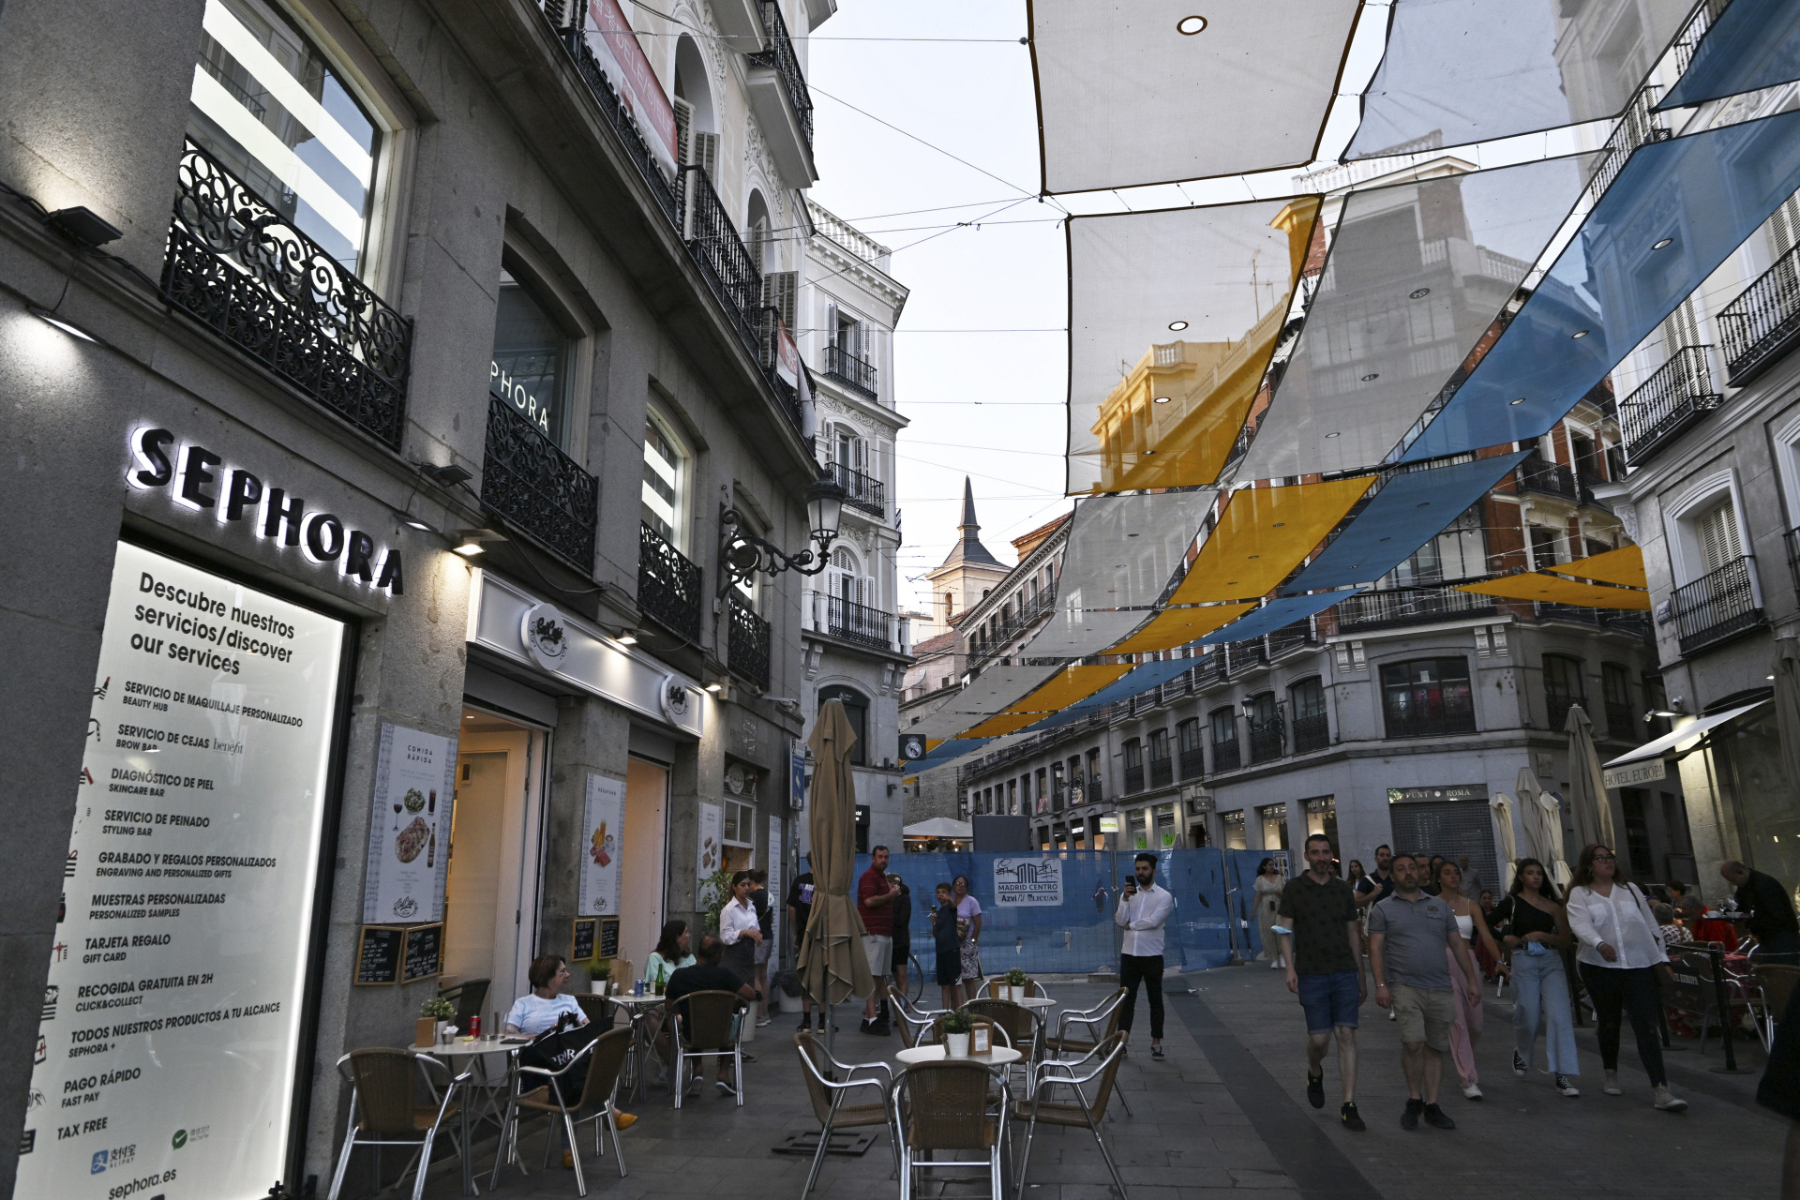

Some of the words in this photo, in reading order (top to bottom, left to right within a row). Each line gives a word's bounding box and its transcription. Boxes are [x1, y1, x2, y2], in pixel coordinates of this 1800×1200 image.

[127, 427, 403, 597] SEPHORA
[139, 572, 226, 617] Descubre
[230, 606, 295, 639] nuestros
[134, 604, 293, 663] servicios/discover
[130, 633, 163, 655] our
[168, 643, 240, 675] services
[122, 696, 152, 710] BEAUTY
[152, 701, 168, 712] HUB
[124, 681, 171, 700] SERVICIO
[173, 691, 185, 704] DE
[187, 693, 240, 715] MAQUILLAJE
[242, 706, 303, 728] PERSONALIZADO
[116, 739, 140, 751] BROW
[118, 724, 165, 741] SERVICIO
[167, 732, 180, 744] DE
[181, 735, 210, 749] CEJAS
[213, 738, 243, 755] benefit
[407, 745, 433, 756] COMIDA
[407, 753, 432, 764] RÁPIDA
[111, 768, 181, 787] DIAGNÓSTICO
[183, 777, 195, 788] DE
[197, 779, 214, 790] PIEL
[1605, 771, 1631, 787] HOTEL
[1632, 764, 1664, 781] EUROPA
[108, 784, 148, 796] SKINCARE
[150, 788, 165, 797] BAR
[1446, 788, 1470, 797] ROMA
[104, 809, 152, 824] SERVICIO
[155, 814, 167, 824] DE
[170, 815, 210, 828] PEINADO
[102, 825, 135, 836] STYLING
[136, 827, 152, 836] BAR
[98, 852, 151, 864] GRABADO
[154, 854, 160, 864] Y
[162, 854, 204, 866] REGALOS
[206, 856, 276, 868] PERSONALIZADOS
[96, 868, 144, 878] ENGRAVING
[145, 868, 162, 878] AND
[163, 868, 212, 878] PERSONALIZED
[214, 870, 232, 878] GIFTS
[92, 894, 145, 907] MUESTRAS
[147, 893, 226, 906] PERSONALIZADAS
[1002, 894, 1017, 902] Azvi
[89, 909, 146, 920] PERSONALIZED
[148, 908, 180, 918] SAMPLES
[85, 934, 128, 950] TARJETA
[132, 934, 171, 947] REGALO
[82, 953, 101, 964] GIFT
[103, 952, 126, 962] CARD
[78, 982, 135, 998] RECOGIDA
[138, 975, 184, 992] GRATUITA
[186, 974, 200, 986] EN
[201, 973, 214, 984] 2H
[76, 996, 143, 1013] CLICK&COLLECT
[71, 1027, 110, 1044] TODOS
[112, 1020, 163, 1037] NUESTROS
[165, 1010, 222, 1030] PRODUCTOS
[222, 1009, 230, 1020] A
[232, 1008, 242, 1019] TU
[243, 1002, 280, 1017] ALCANCE
[68, 1044, 108, 1058] SEPHORA
[64, 1076, 98, 1094] PAGO
[100, 1067, 141, 1086] RÁPIDO
[62, 1095, 82, 1108] FAST
[84, 1092, 101, 1104] PAY
[57, 1125, 80, 1140] TAX
[82, 1117, 108, 1134] FREE
[110, 1144, 136, 1161] 支付宝
[109, 1156, 134, 1168] ALIPAY
[108, 1168, 177, 1200] sephora.es
